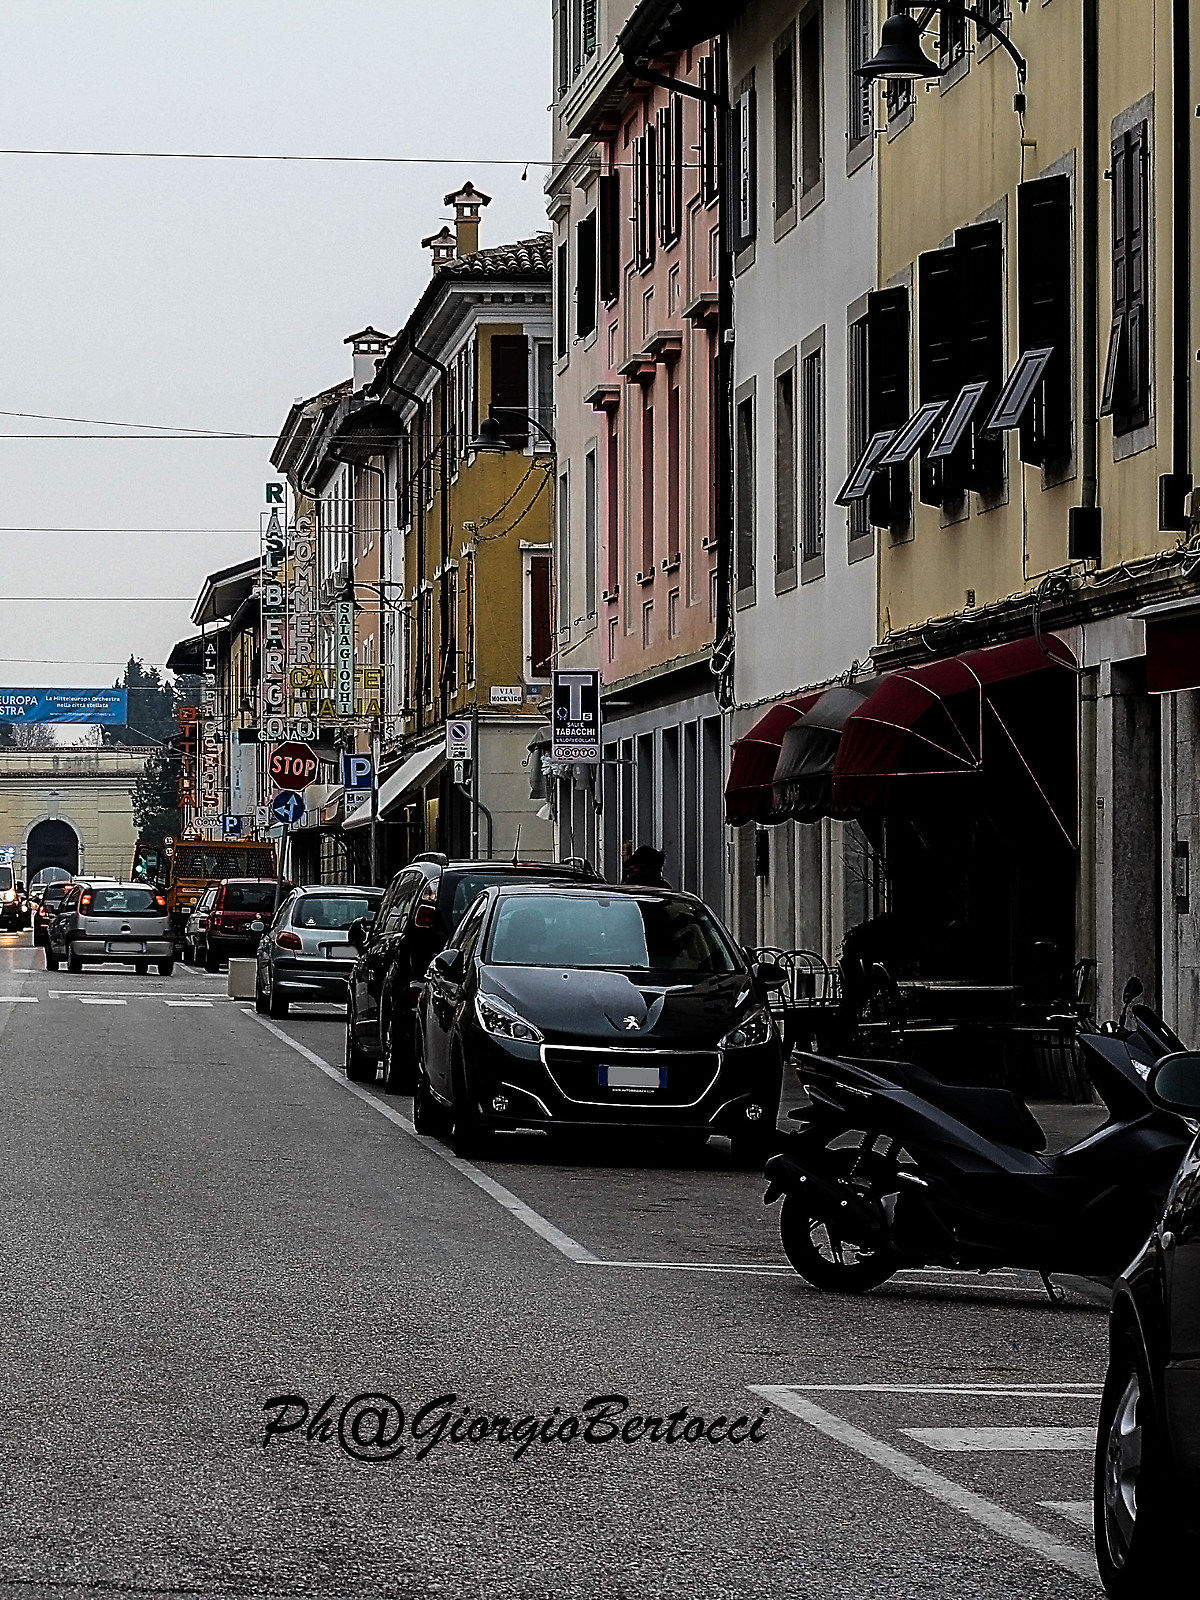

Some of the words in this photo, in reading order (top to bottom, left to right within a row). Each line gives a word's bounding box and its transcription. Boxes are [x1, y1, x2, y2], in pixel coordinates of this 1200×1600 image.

[266, 515, 284, 737] ALBERGO
[338, 603, 351, 646] SALA
[338, 648, 351, 714] GIOCHI
[53, 695, 91, 703] Mitteleuropa
[289, 698, 382, 718] ITAIA
[558, 674, 593, 721] T
[555, 728, 596, 736] TABACCHI
[555, 748, 597, 758] LOTTO
[271, 755, 316, 777] STOP
[350, 757, 371, 786] P
[225, 816, 237, 832] P
